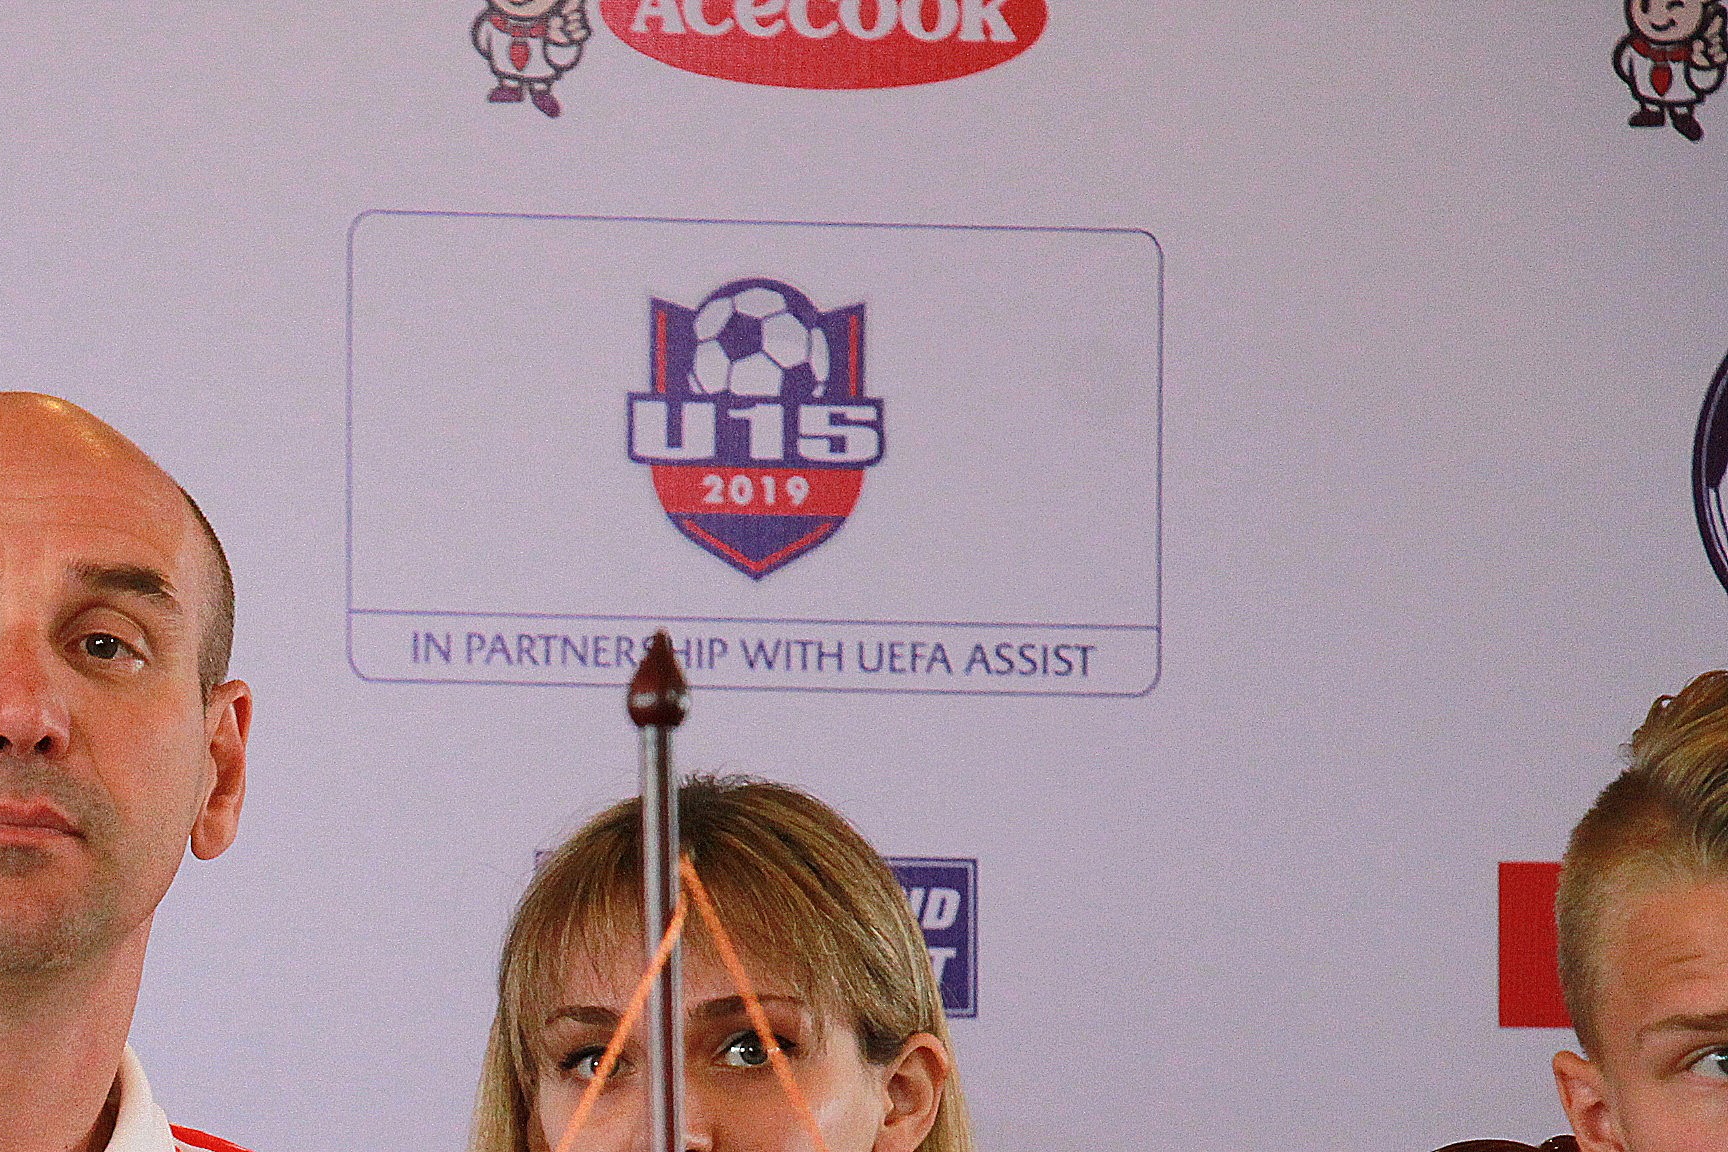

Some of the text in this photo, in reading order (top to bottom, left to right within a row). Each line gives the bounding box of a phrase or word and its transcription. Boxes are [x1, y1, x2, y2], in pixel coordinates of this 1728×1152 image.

[633, 400, 878, 462] U15
[702, 474, 809, 505] 2019
[412, 631, 452, 664] IN
[740, 638, 844, 672] WITH
[858, 641, 953, 676] UEFA
[963, 643, 1096, 677] ASSIST
